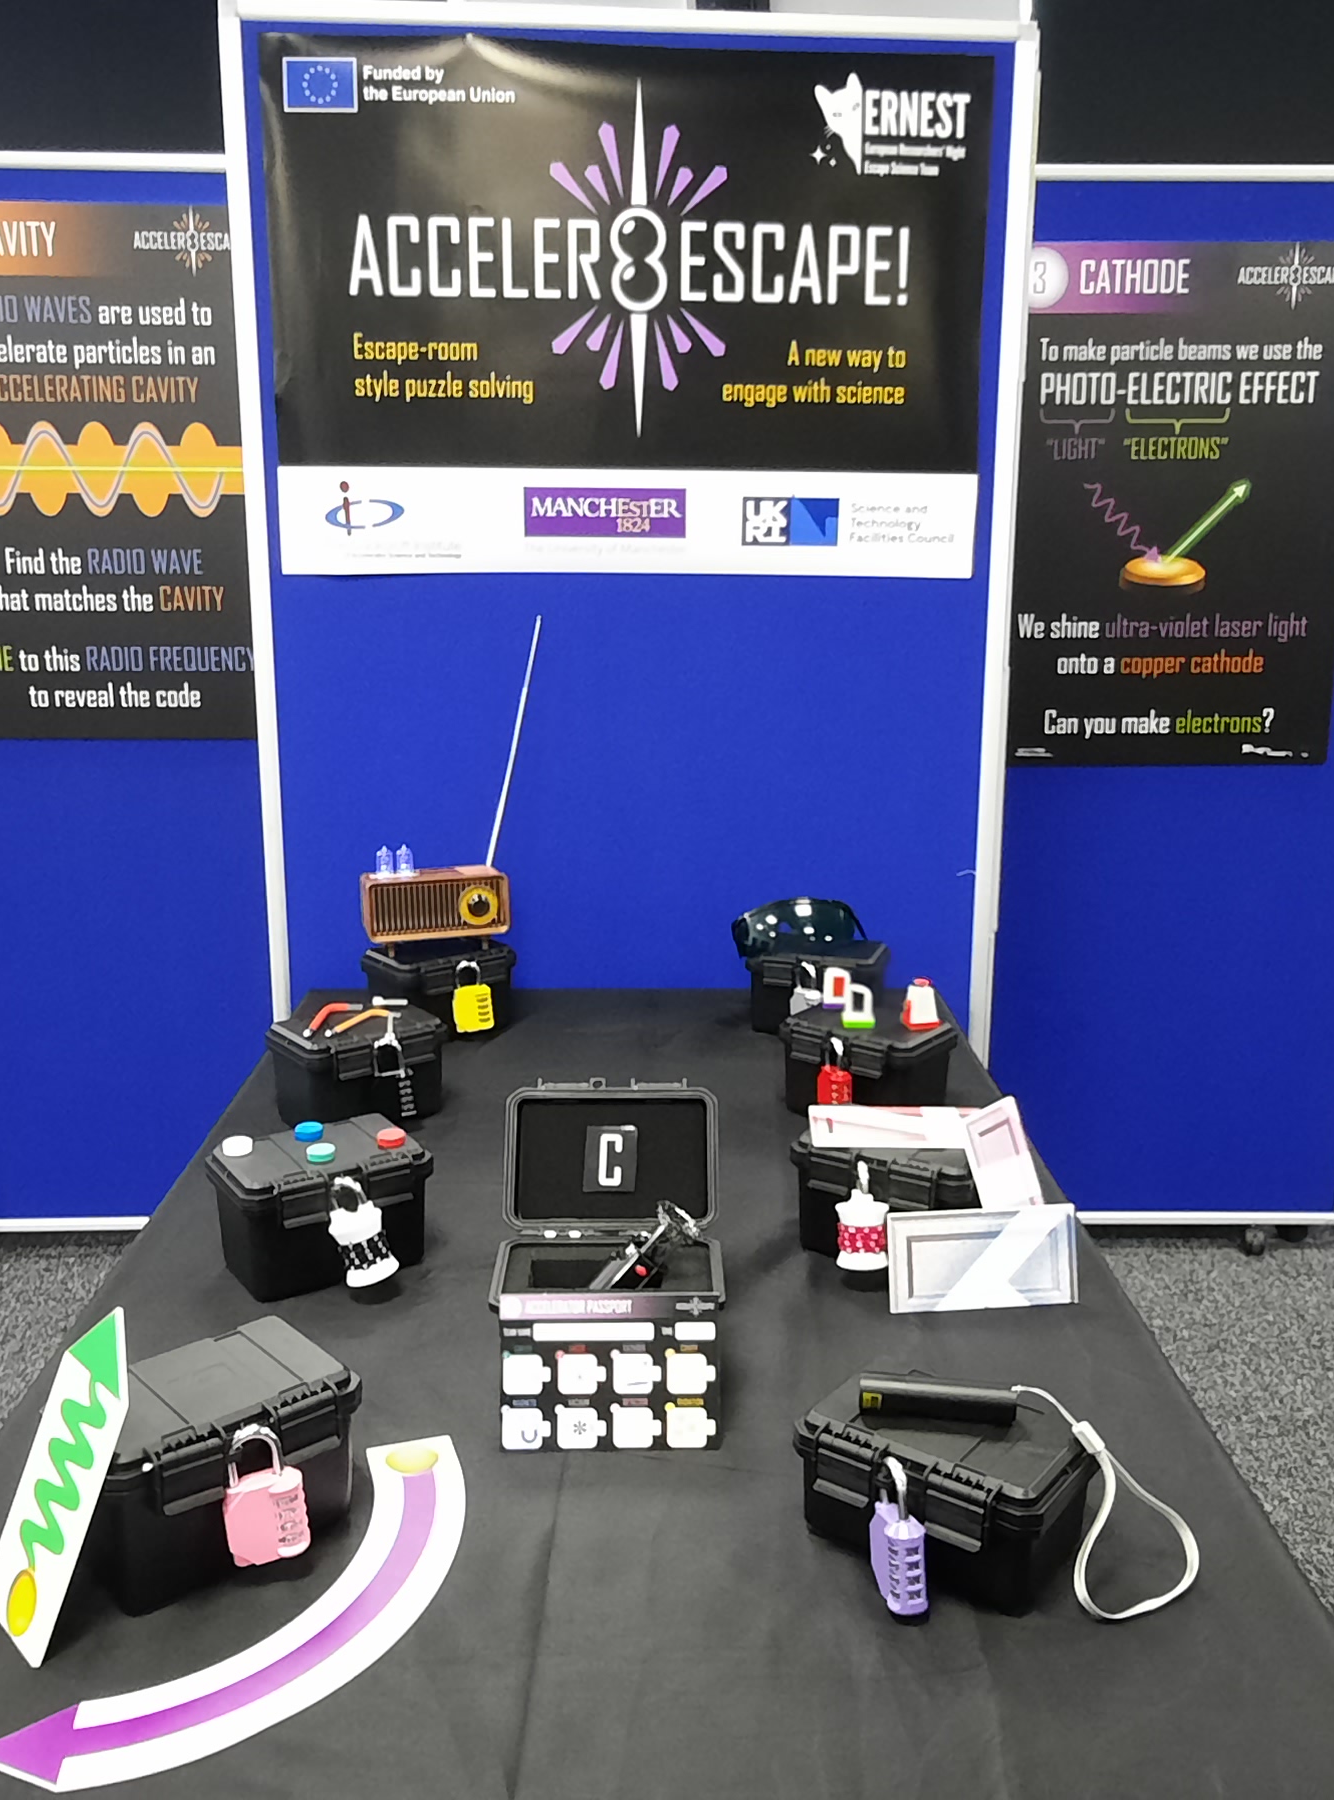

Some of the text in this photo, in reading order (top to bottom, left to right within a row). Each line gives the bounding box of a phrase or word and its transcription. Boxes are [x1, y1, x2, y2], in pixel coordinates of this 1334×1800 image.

[363, 65, 444, 84] Funded by
[363, 86, 516, 104] the European Union
[865, 90, 971, 139] ERNEST
[1033, 261, 1047, 294] 3
[1079, 258, 1191, 295] CATHODE
[24, 295, 92, 325] WAVES
[98, 303, 132, 326] are
[139, 298, 185, 326] used
[191, 302, 212, 326] to
[353, 332, 478, 364] Escape-room
[788, 340, 906, 372] A new way to
[1039, 336, 1323, 365] To make particle beams we use the
[132, 376, 198, 403] CAVITY
[354, 370, 534, 403] style puzzle solving
[722, 379, 905, 408] engage with science
[1039, 371, 1320, 405] PHOTO-ELECTRIC EFFECT
[531, 497, 683, 518] MANCHESTER
[851, 503, 928, 514] Science and
[616, 518, 651, 533] 1824
[849, 533, 955, 544] Facilities Council
[851, 518, 921, 531] Technology
[4, 547, 204, 576] Find the RADIO WAVE
[1017, 612, 1308, 643] We shine ultra-violet laser light
[18, 650, 39, 672] to
[43, 645, 80, 672] this
[86, 646, 143, 672] RADIO
[1044, 707, 1275, 739] Can you make electrons?
[598, 1133, 623, 1187] C
